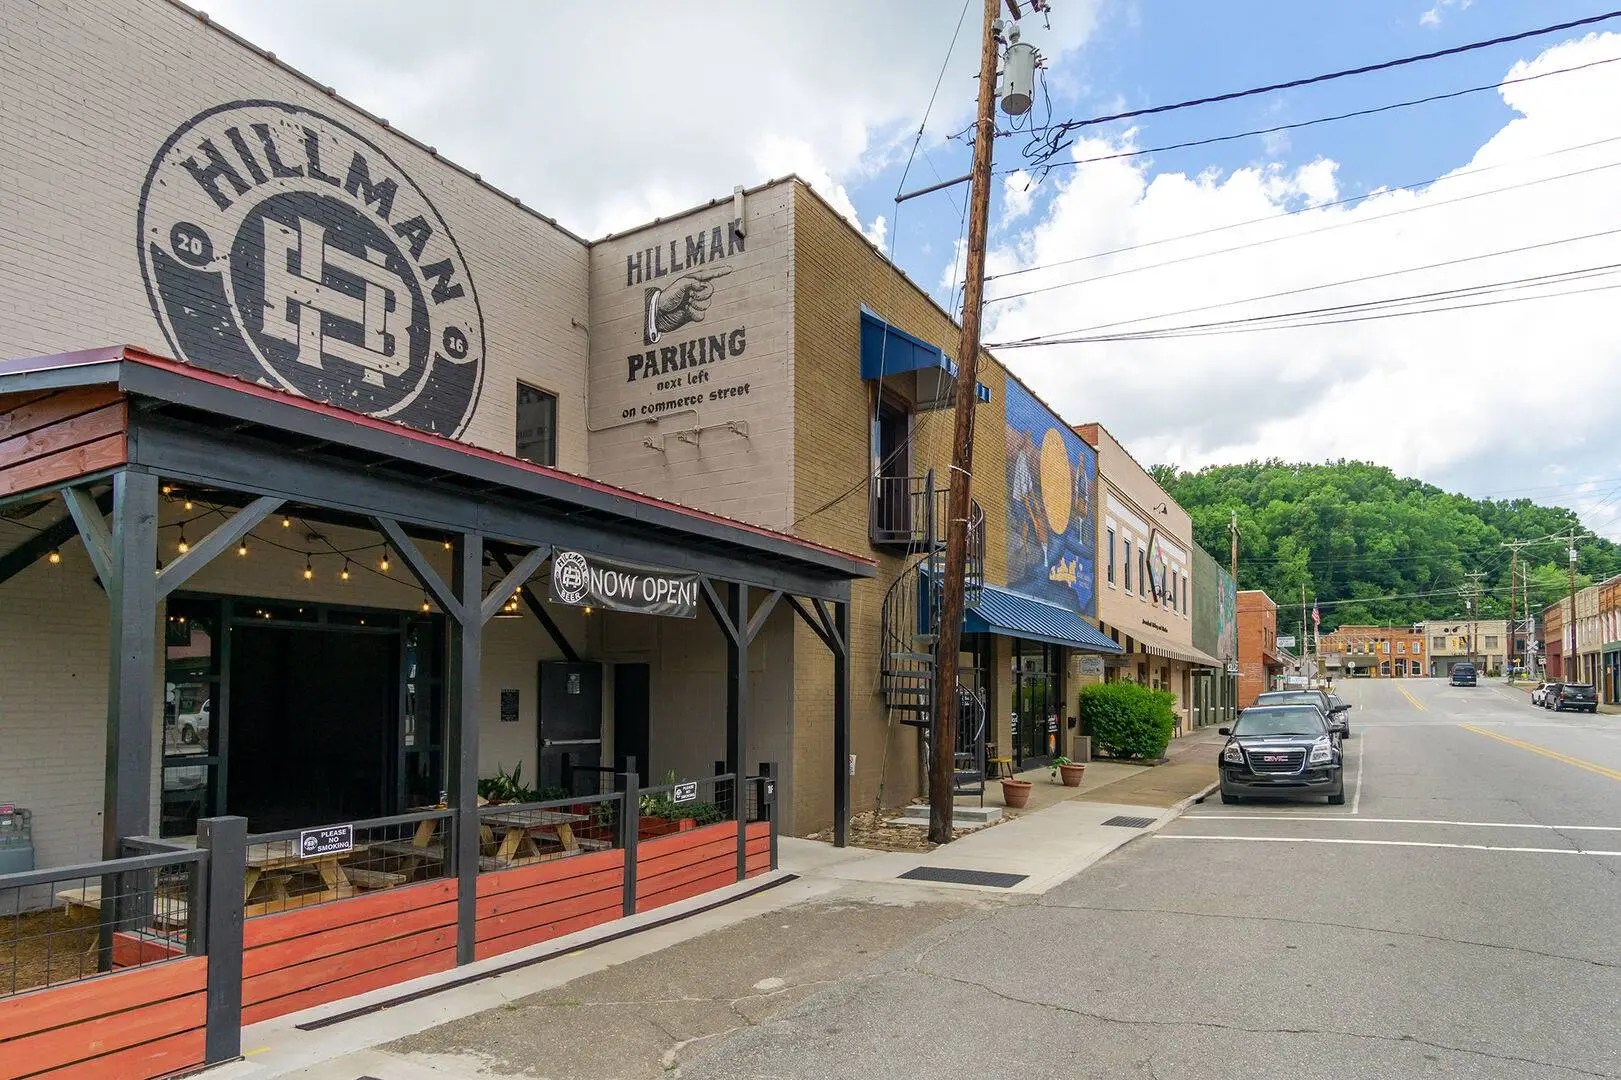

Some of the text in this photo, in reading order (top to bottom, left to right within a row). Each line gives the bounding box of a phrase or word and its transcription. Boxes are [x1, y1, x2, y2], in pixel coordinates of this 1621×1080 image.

[179, 123, 465, 306] HILLMAN
[177, 232, 203, 257] 20
[626, 218, 746, 287] HILLMAN
[627, 326, 746, 383] PARKING
[656, 370, 709, 391] next left
[622, 383, 750, 418] on commerce street
[561, 590, 580, 601] BEER
[591, 567, 697, 606] NOW OPEN!
[317, 842, 349, 851] SMOKING
[321, 829, 346, 837] PLEASE
